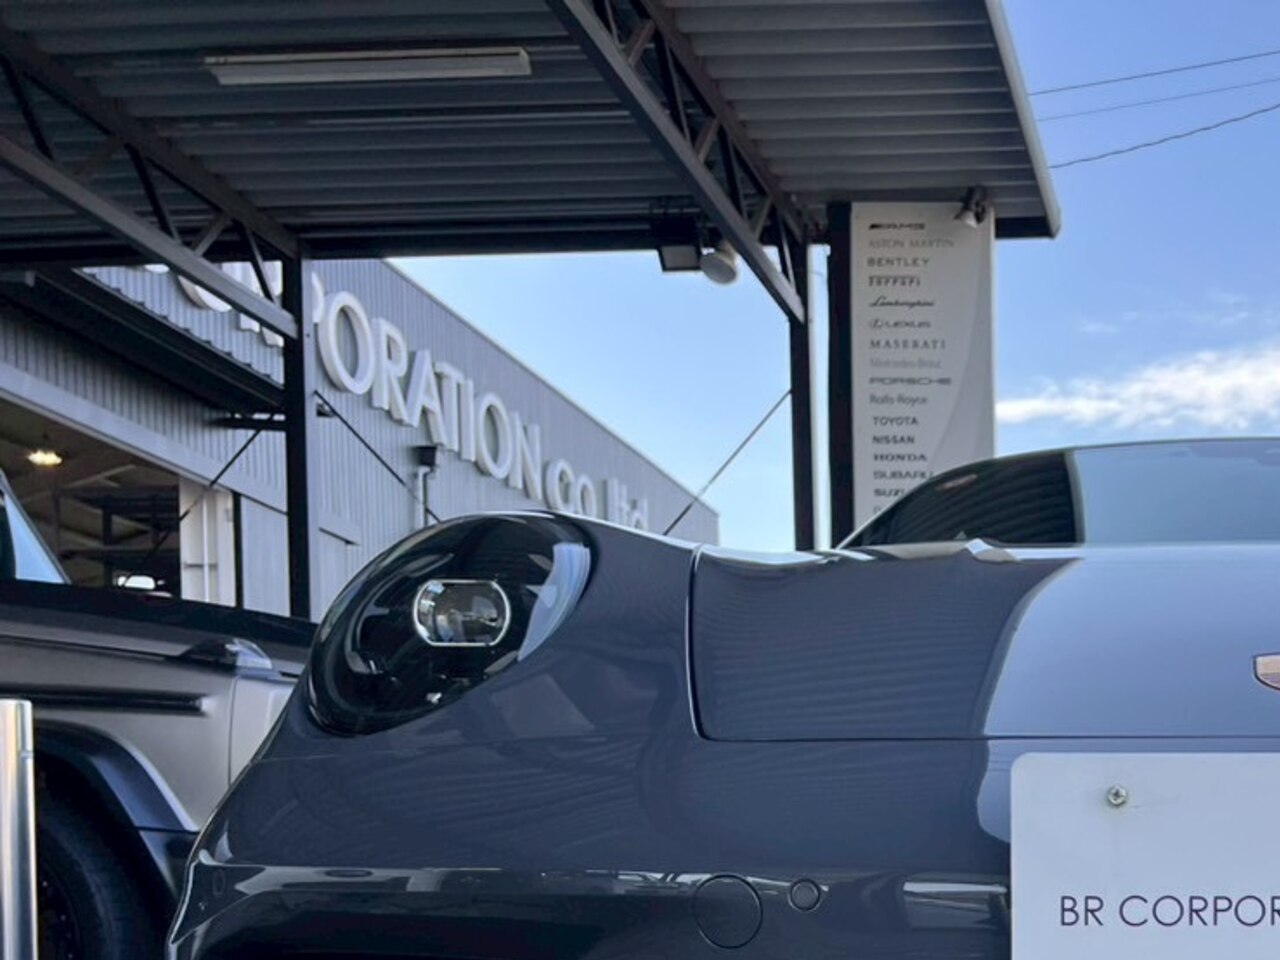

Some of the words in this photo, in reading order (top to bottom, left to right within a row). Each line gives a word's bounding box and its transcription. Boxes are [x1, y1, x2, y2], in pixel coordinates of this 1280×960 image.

[867, 257, 930, 267] BENTLEY
[869, 339, 947, 350] MASERATI
[869, 377, 952, 385] PORSCHE
[873, 416, 919, 426] TOYOTA
[872, 435, 915, 444] NISSAN
[873, 453, 928, 462] HONDA
[1060, 895, 1104, 926] BR
